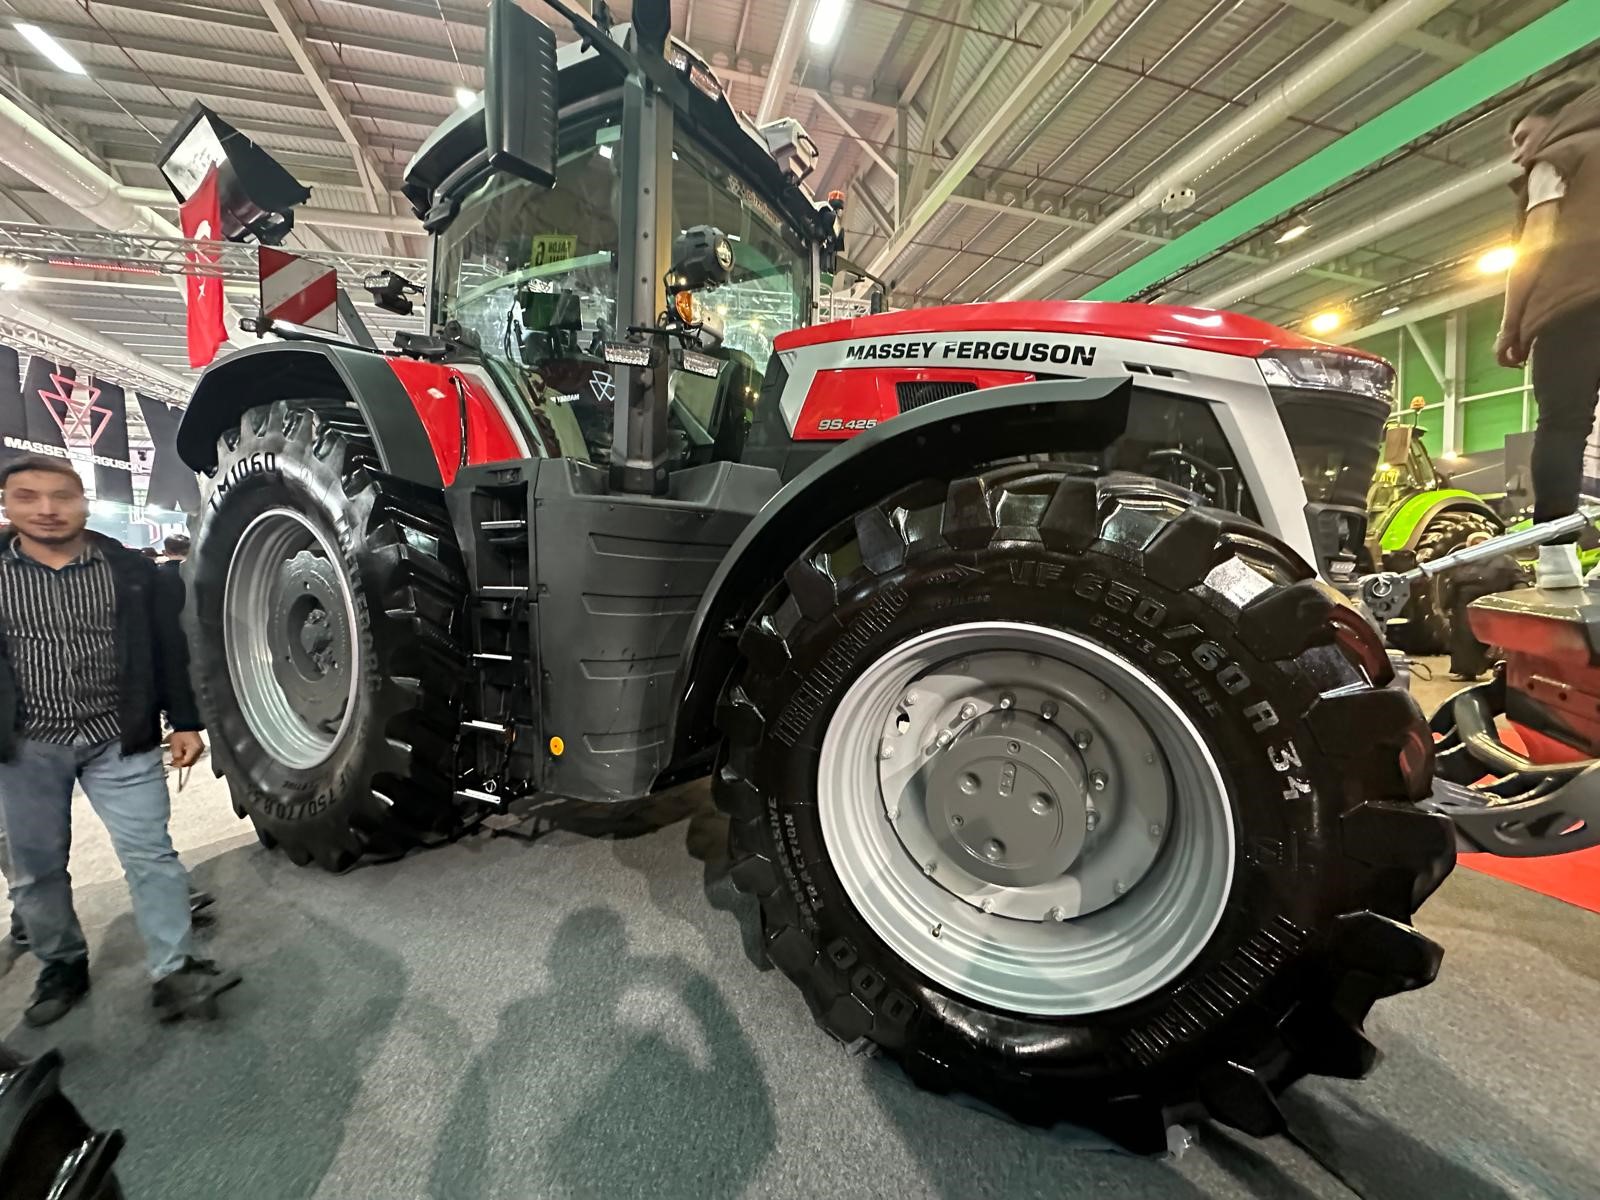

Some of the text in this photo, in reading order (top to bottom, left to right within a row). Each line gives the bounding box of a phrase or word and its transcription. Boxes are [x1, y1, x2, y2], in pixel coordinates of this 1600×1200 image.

[846, 341, 1096, 366] MASSEY FERGUSON
[818, 419, 878, 430] 9S.425
[3, 436, 70, 459] MASSEY
[207, 451, 276, 513] TM1060
[1009, 559, 1312, 801] VF 650/60 R 34
[783, 812, 825, 913] TRACTION
